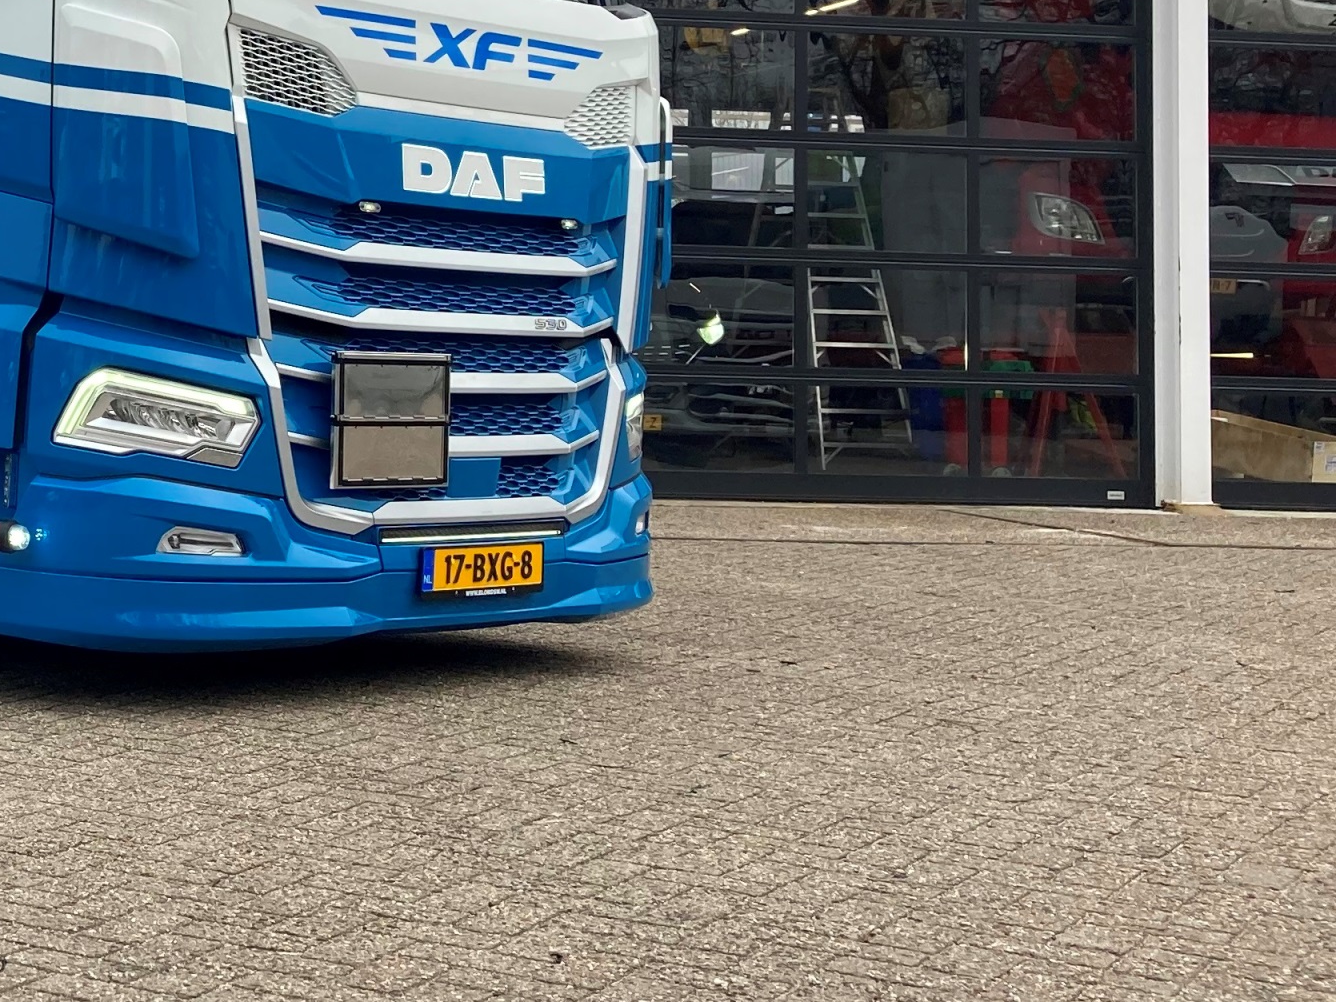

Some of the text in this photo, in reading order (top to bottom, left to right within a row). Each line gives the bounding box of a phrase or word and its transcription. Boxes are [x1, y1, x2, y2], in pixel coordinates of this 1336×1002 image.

[423, 22, 522, 71] XF
[401, 143, 546, 202] DAF
[534, 318, 568, 331] 530
[423, 574, 433, 584] NL
[445, 550, 532, 584] 17-BXG-8
